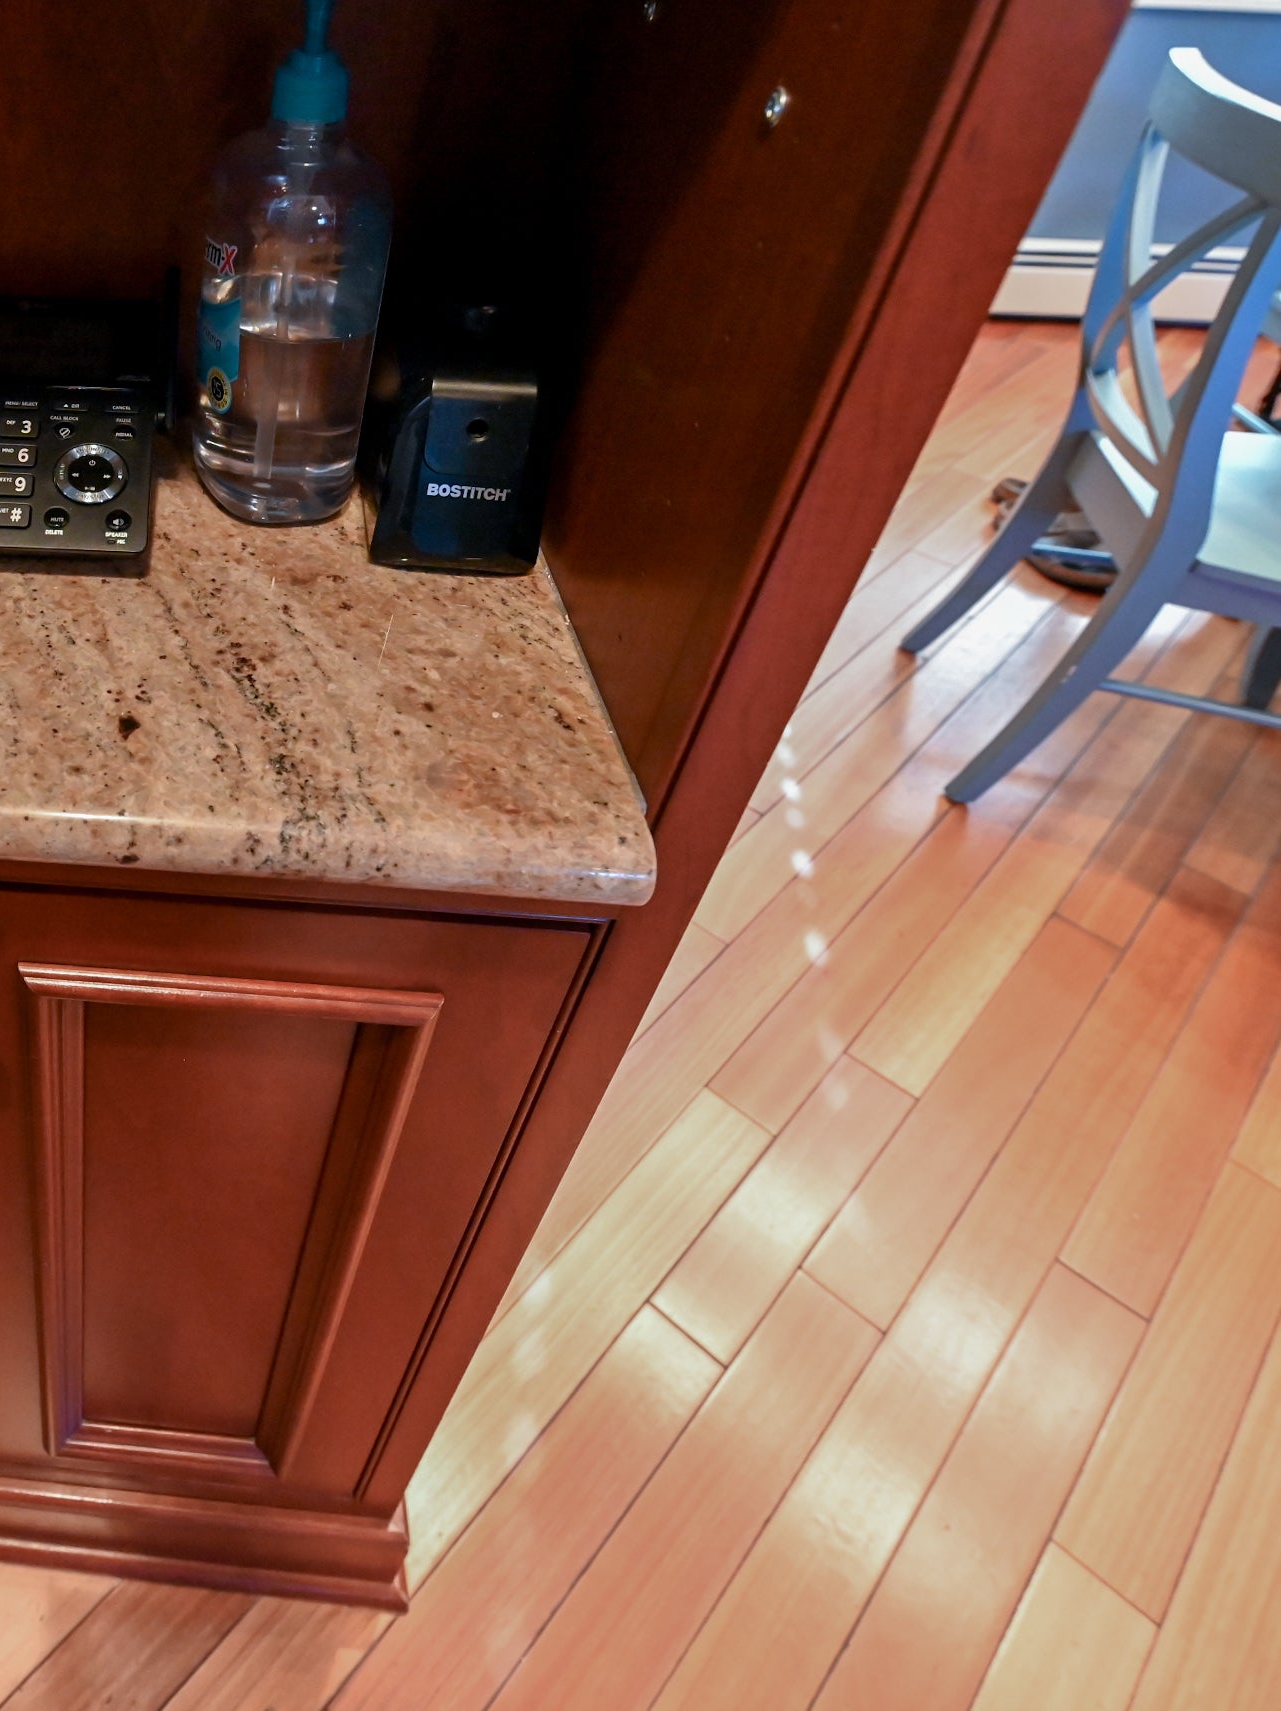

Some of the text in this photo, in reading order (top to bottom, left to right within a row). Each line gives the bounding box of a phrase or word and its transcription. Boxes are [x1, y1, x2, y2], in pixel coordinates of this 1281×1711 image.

[20, 420, 32, 434] 3
[18, 448, 29, 463] 6
[14, 476, 26, 492] 9
[426, 483, 507, 502] BOSTITCH
[9, 507, 22, 522] #
